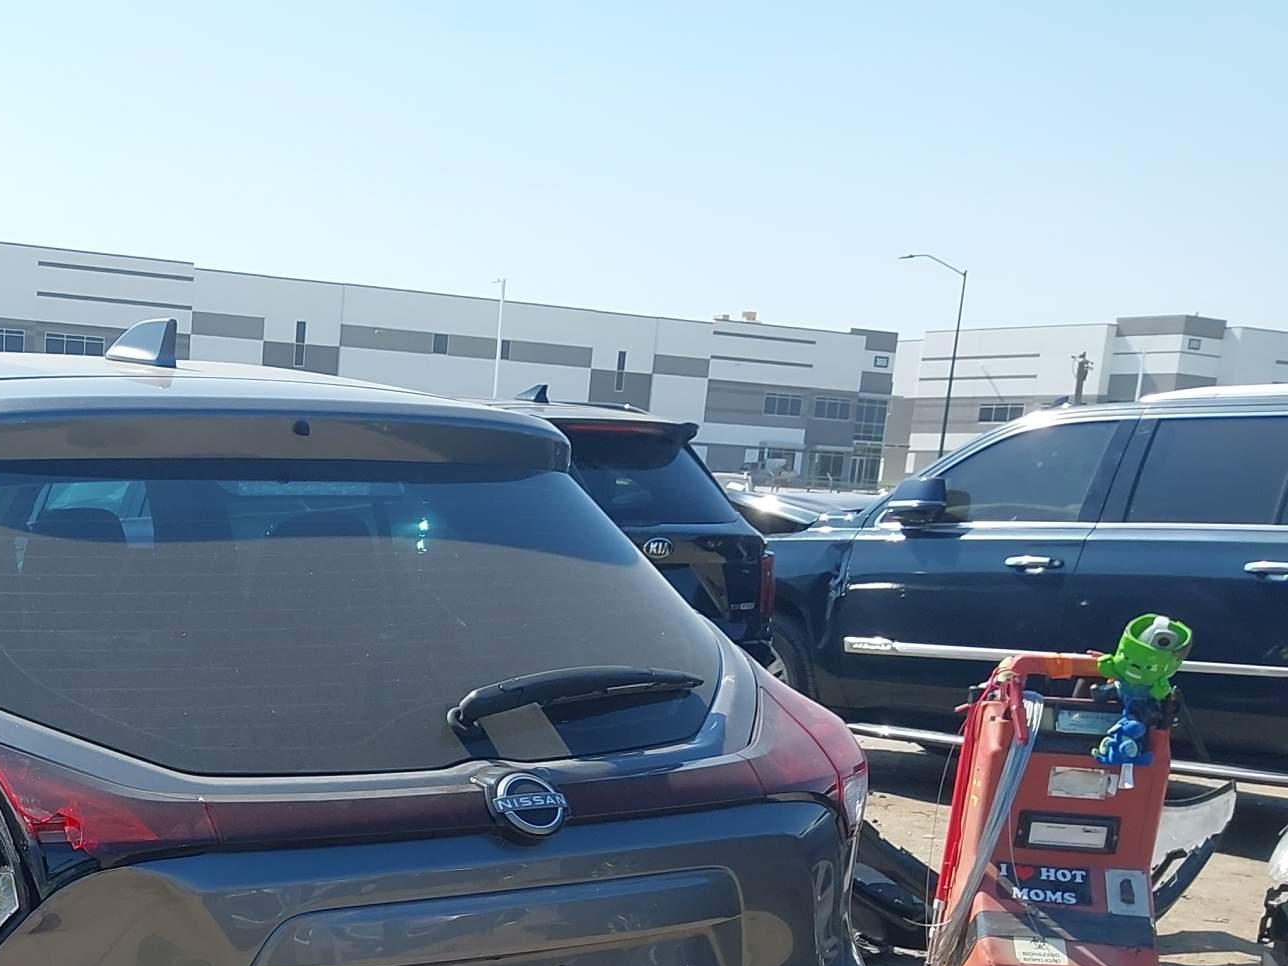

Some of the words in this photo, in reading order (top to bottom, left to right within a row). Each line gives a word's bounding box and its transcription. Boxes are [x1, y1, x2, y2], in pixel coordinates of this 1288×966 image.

[649, 541, 670, 554] KIA
[497, 795, 566, 810] NISSAN
[1000, 863, 1008, 876] I
[1040, 867, 1087, 883] HOT
[1012, 886, 1077, 904] MOMS
